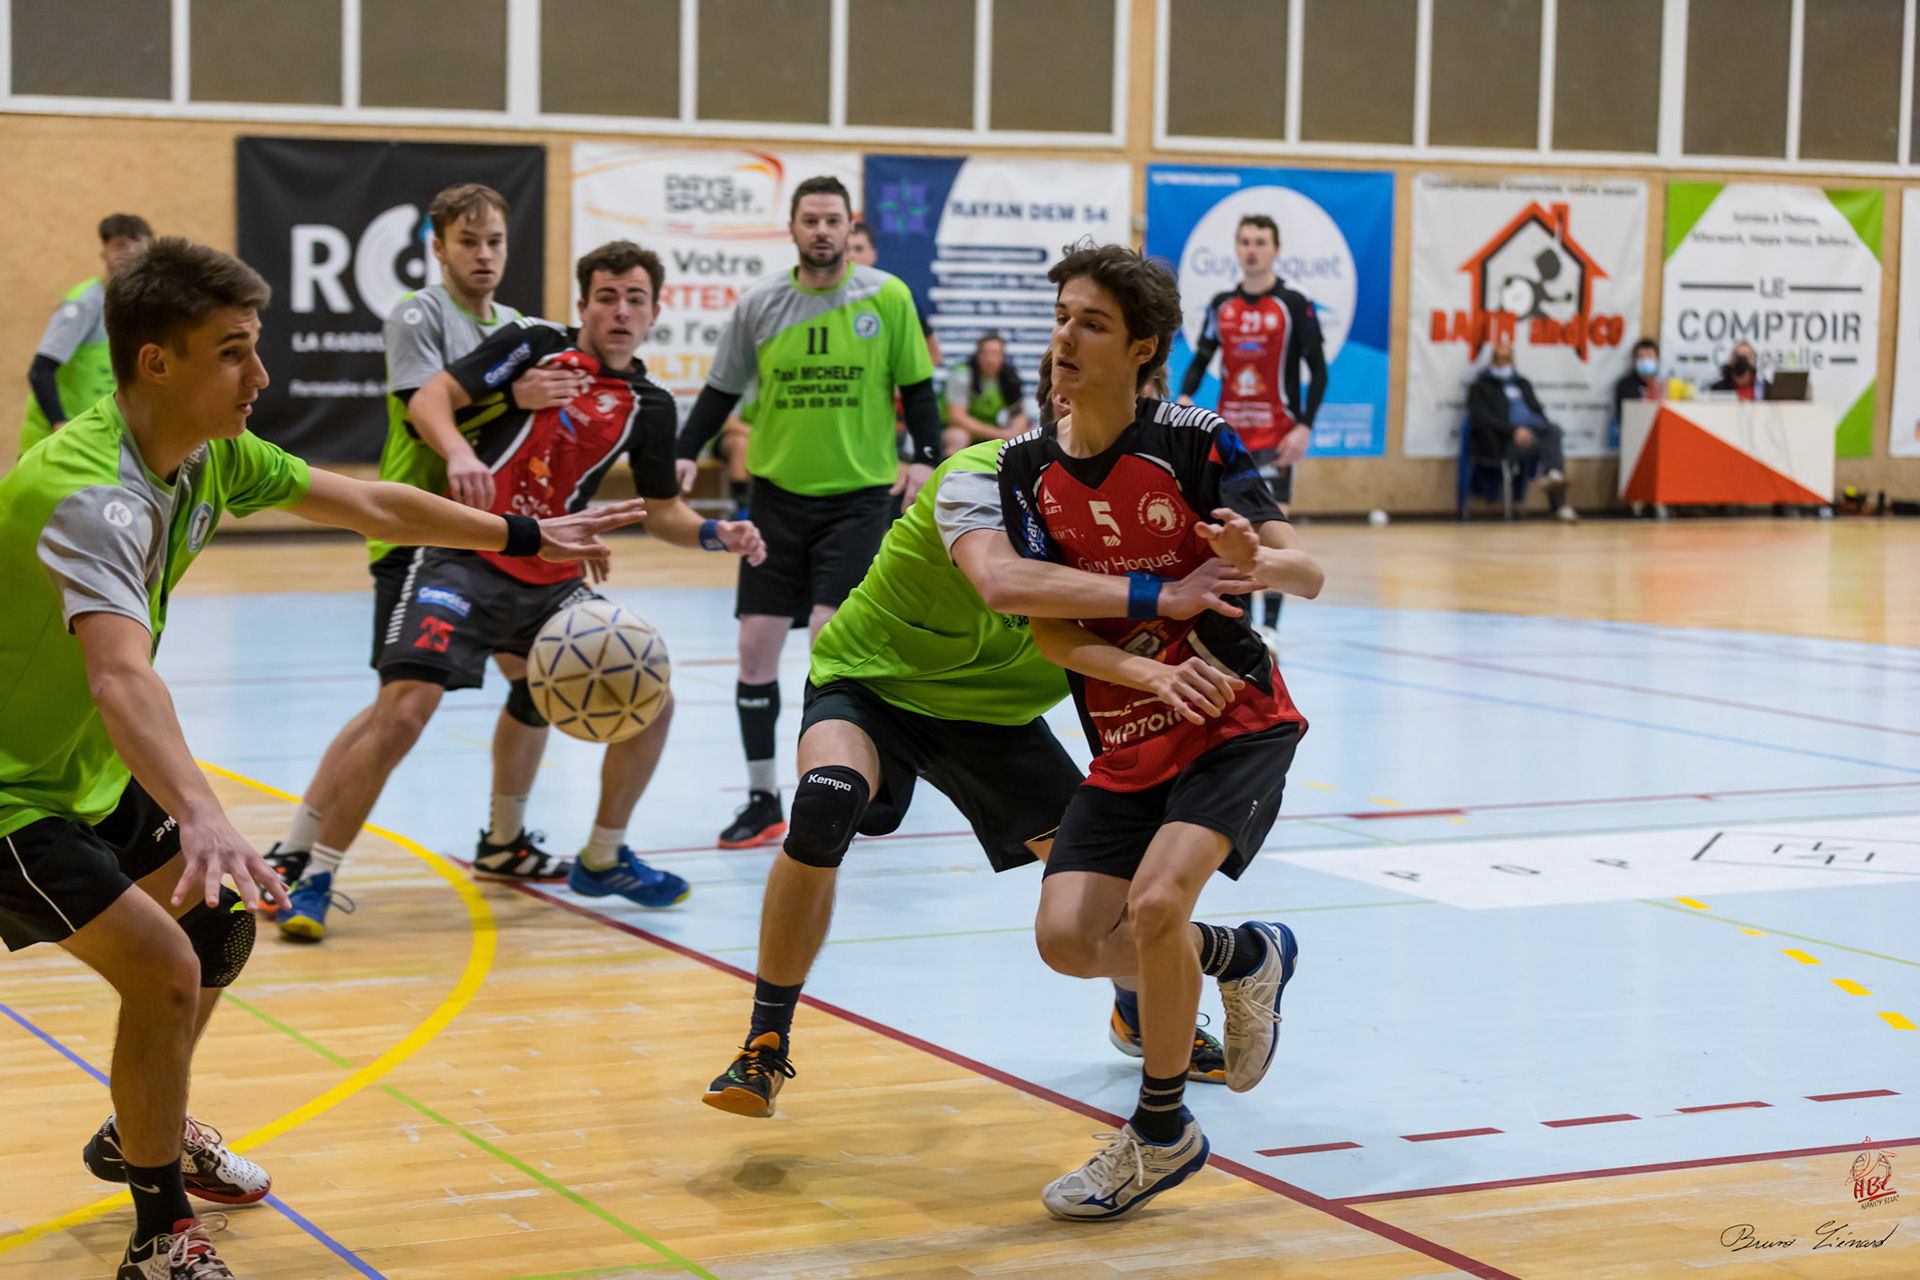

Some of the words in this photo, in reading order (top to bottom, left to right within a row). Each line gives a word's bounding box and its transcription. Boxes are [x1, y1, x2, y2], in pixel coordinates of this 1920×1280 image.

[671, 249, 763, 276] Votre
[1190, 248, 1243, 281] Guy
[1270, 253, 1343, 281] oquet
[1760, 278, 1785, 299] LE
[1677, 310, 1862, 344] COMPTOIR
[806, 327, 829, 355] 11
[801, 366, 864, 381] MICHELET
[1088, 500, 1122, 537] 5
[1077, 556, 1109, 575] Guy
[1110, 549, 1183, 573] Hoquet
[1103, 706, 1183, 745] MPTOI
[807, 773, 853, 792] Kempa
